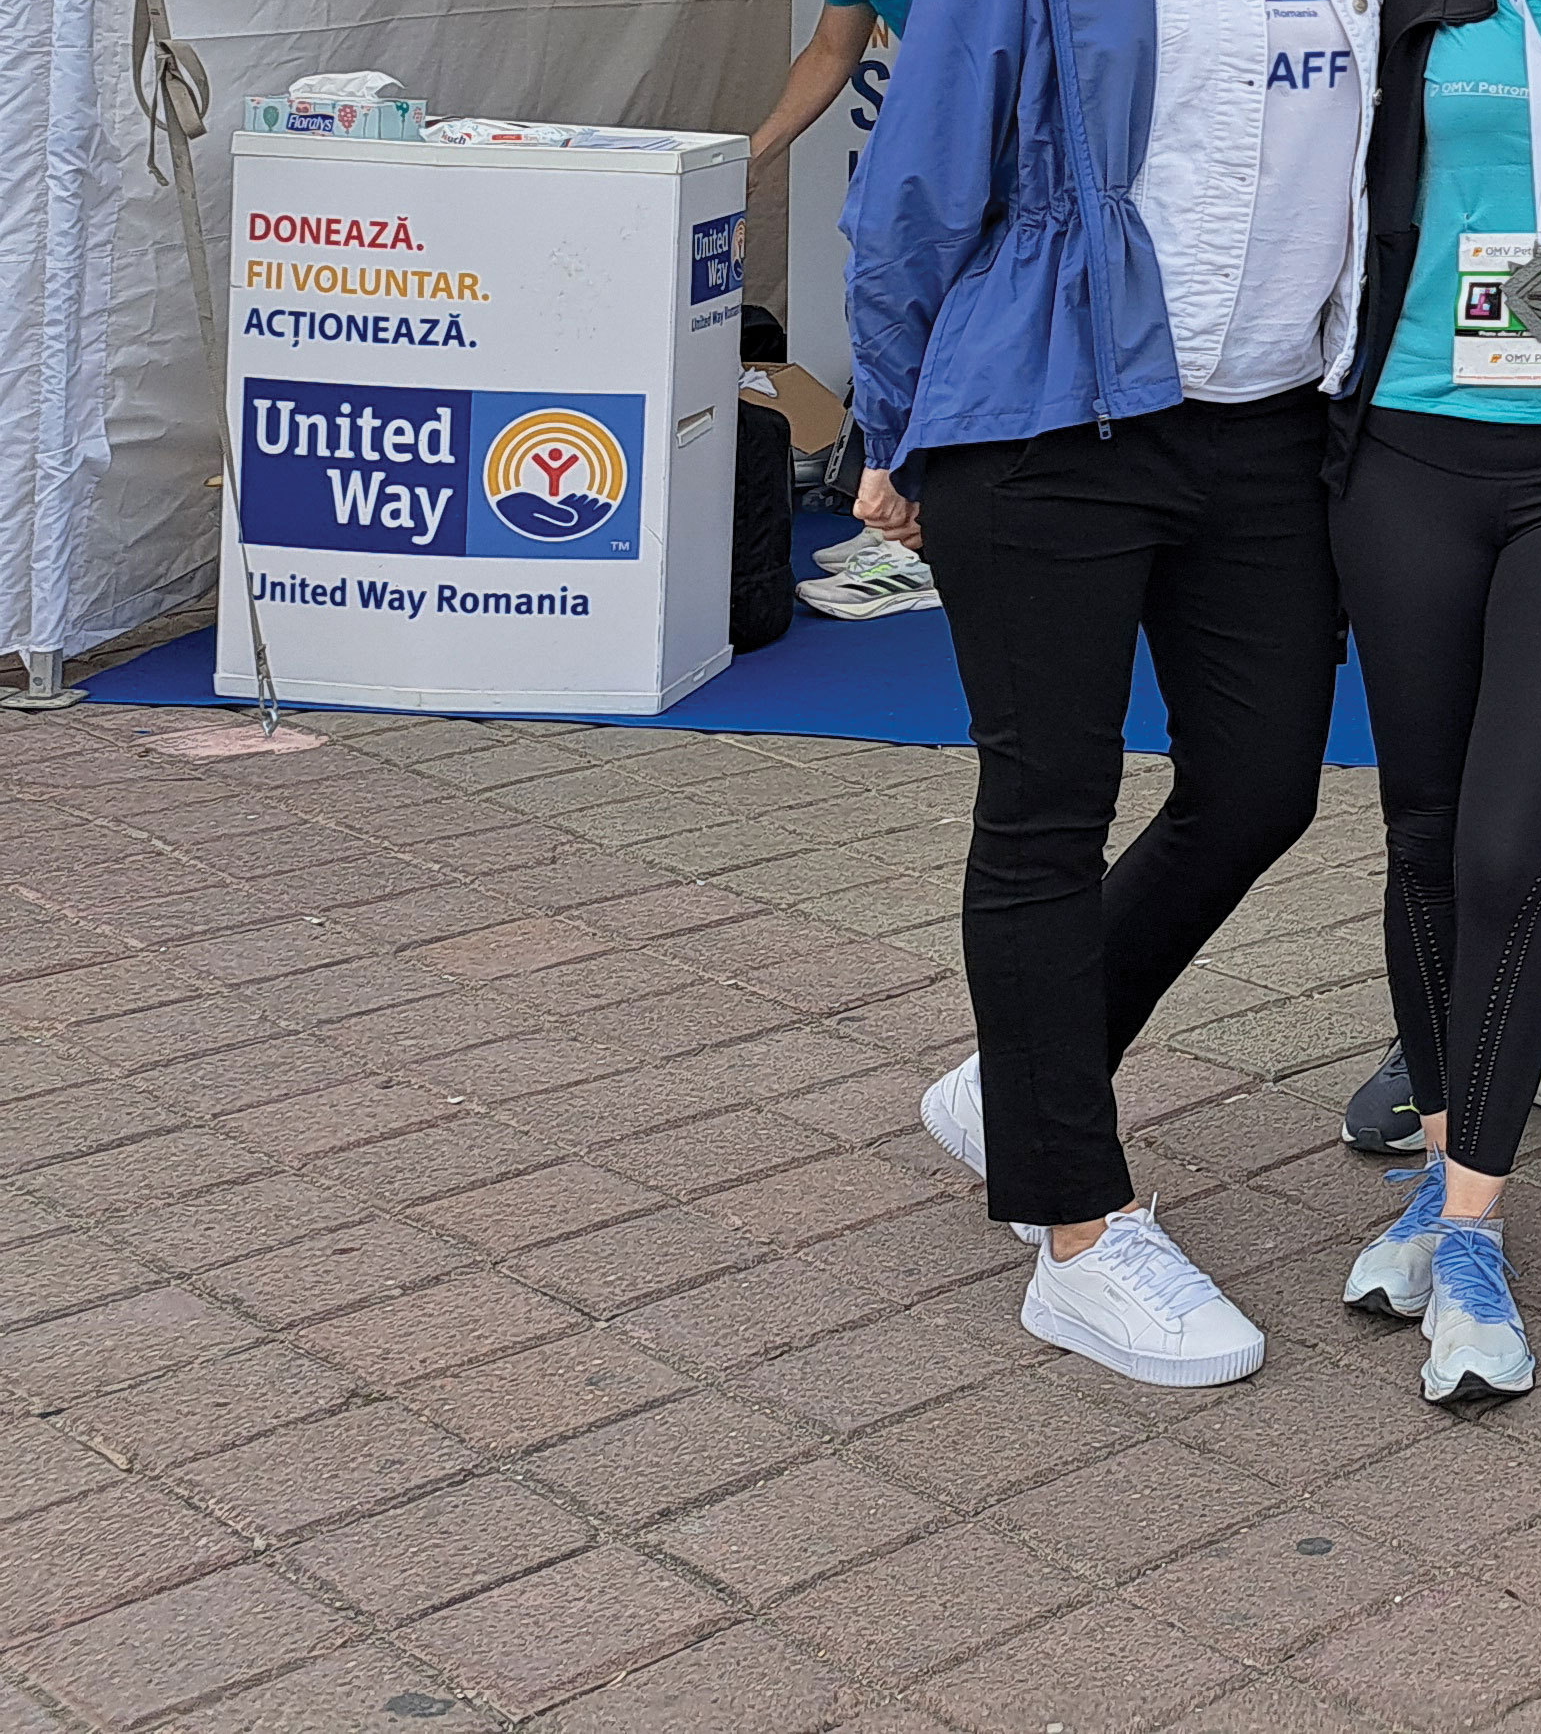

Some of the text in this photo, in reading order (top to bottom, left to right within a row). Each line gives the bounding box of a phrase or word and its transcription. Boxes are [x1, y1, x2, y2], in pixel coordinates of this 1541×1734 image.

[1441, 82, 1474, 94] OMV
[289, 115, 333, 133] Floralys
[248, 213, 424, 251] DONEAZĂ.
[695, 223, 728, 261] United
[1486, 247, 1511, 255] OMV
[246, 260, 490, 302] FII VOLUNTAR.
[708, 259, 728, 290] Way
[244, 307, 477, 348] ACȚIONEAZĂ.
[1505, 354, 1531, 363] OMV
[253, 399, 454, 463] United
[327, 469, 453, 545] Way
[248, 572, 590, 620] United Way Romania
